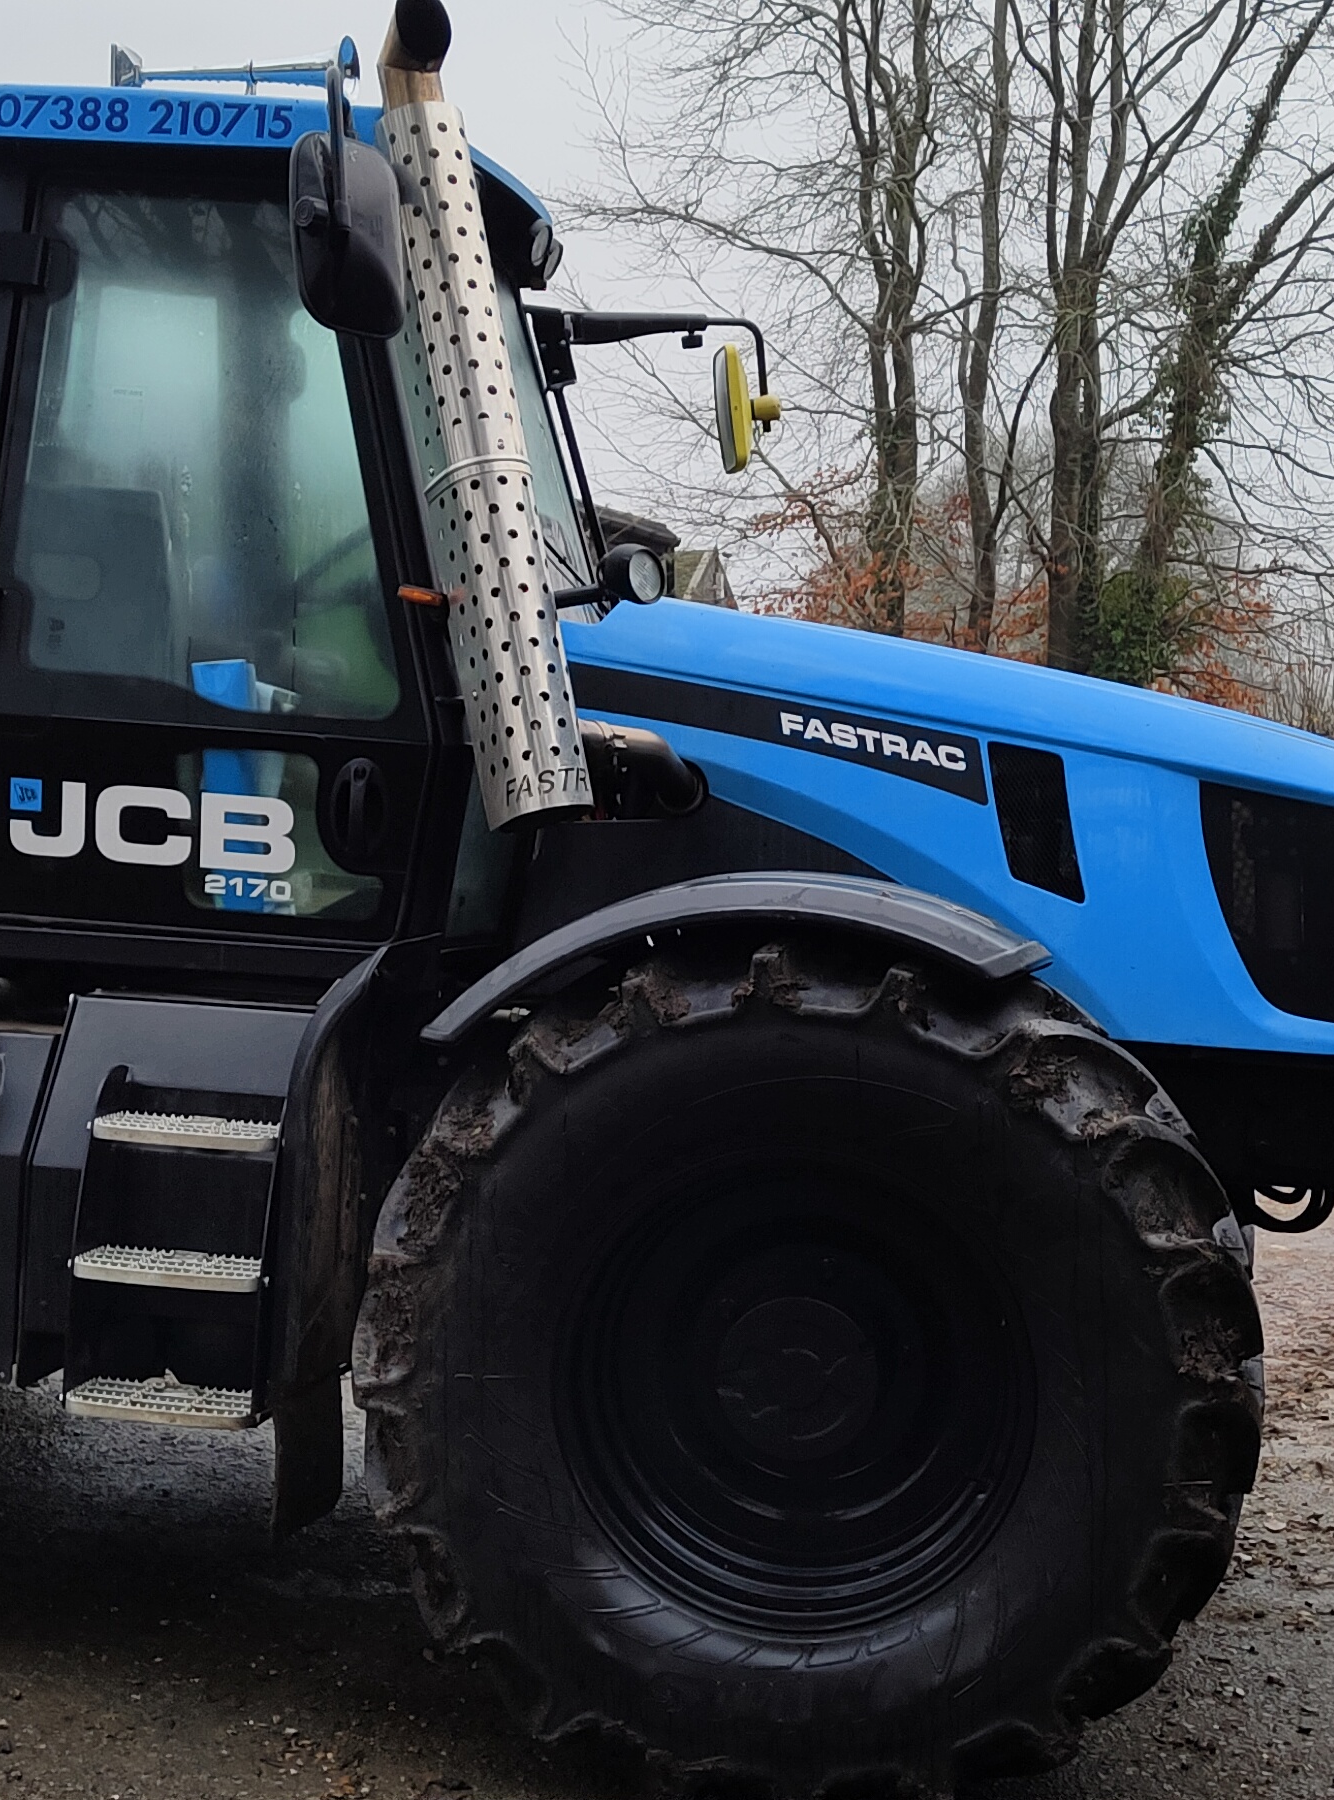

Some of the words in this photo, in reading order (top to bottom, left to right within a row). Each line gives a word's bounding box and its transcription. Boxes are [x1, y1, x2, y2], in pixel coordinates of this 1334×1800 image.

[147, 100, 293, 140] 210715
[780, 711, 967, 771] FASTRAC
[10, 781, 296, 874] JCB
[204, 874, 292, 900] 2170
